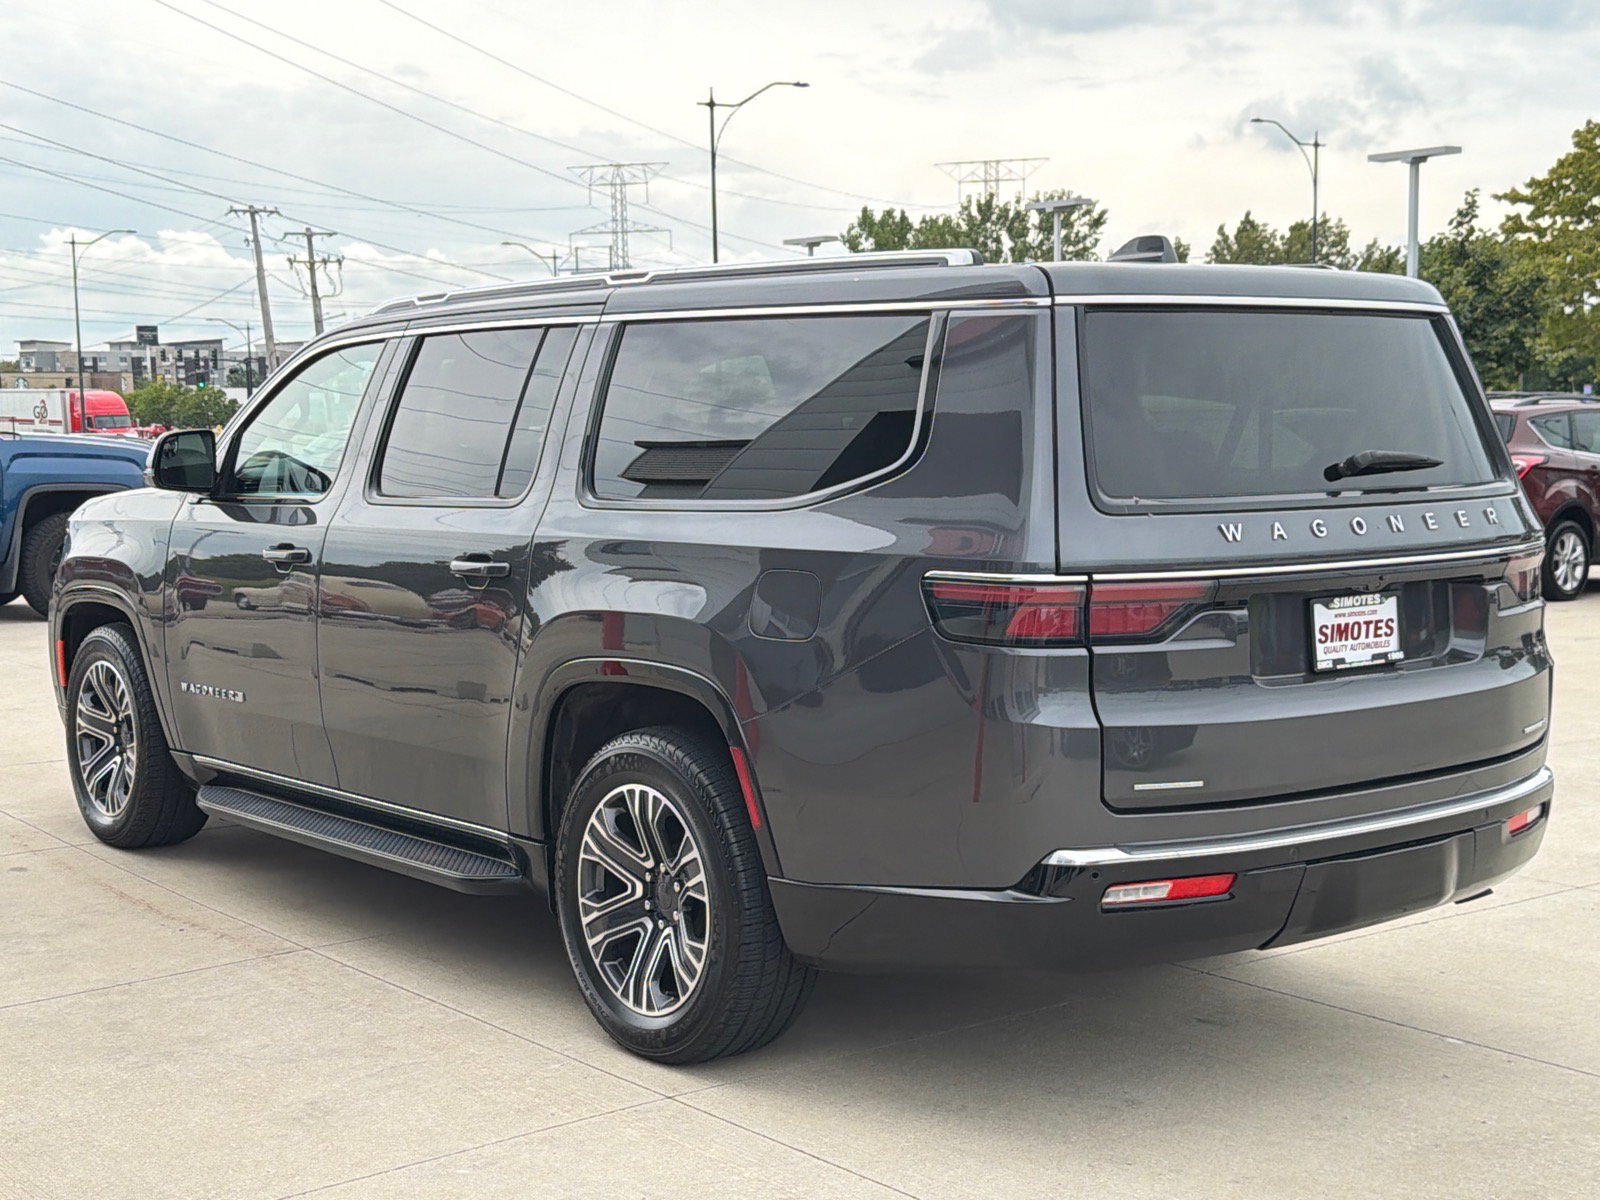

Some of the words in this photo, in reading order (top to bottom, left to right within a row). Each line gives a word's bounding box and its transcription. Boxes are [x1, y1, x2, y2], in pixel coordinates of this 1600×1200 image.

[1219, 507, 1499, 542] WAGONEER
[1333, 593, 1381, 608] SIMOTES
[1318, 618, 1395, 644] SIMOTES
[1323, 644, 1348, 655] QUALITY
[1350, 639, 1391, 651] AUTOMOBILES
[181, 682, 235, 701] WAGONEER
